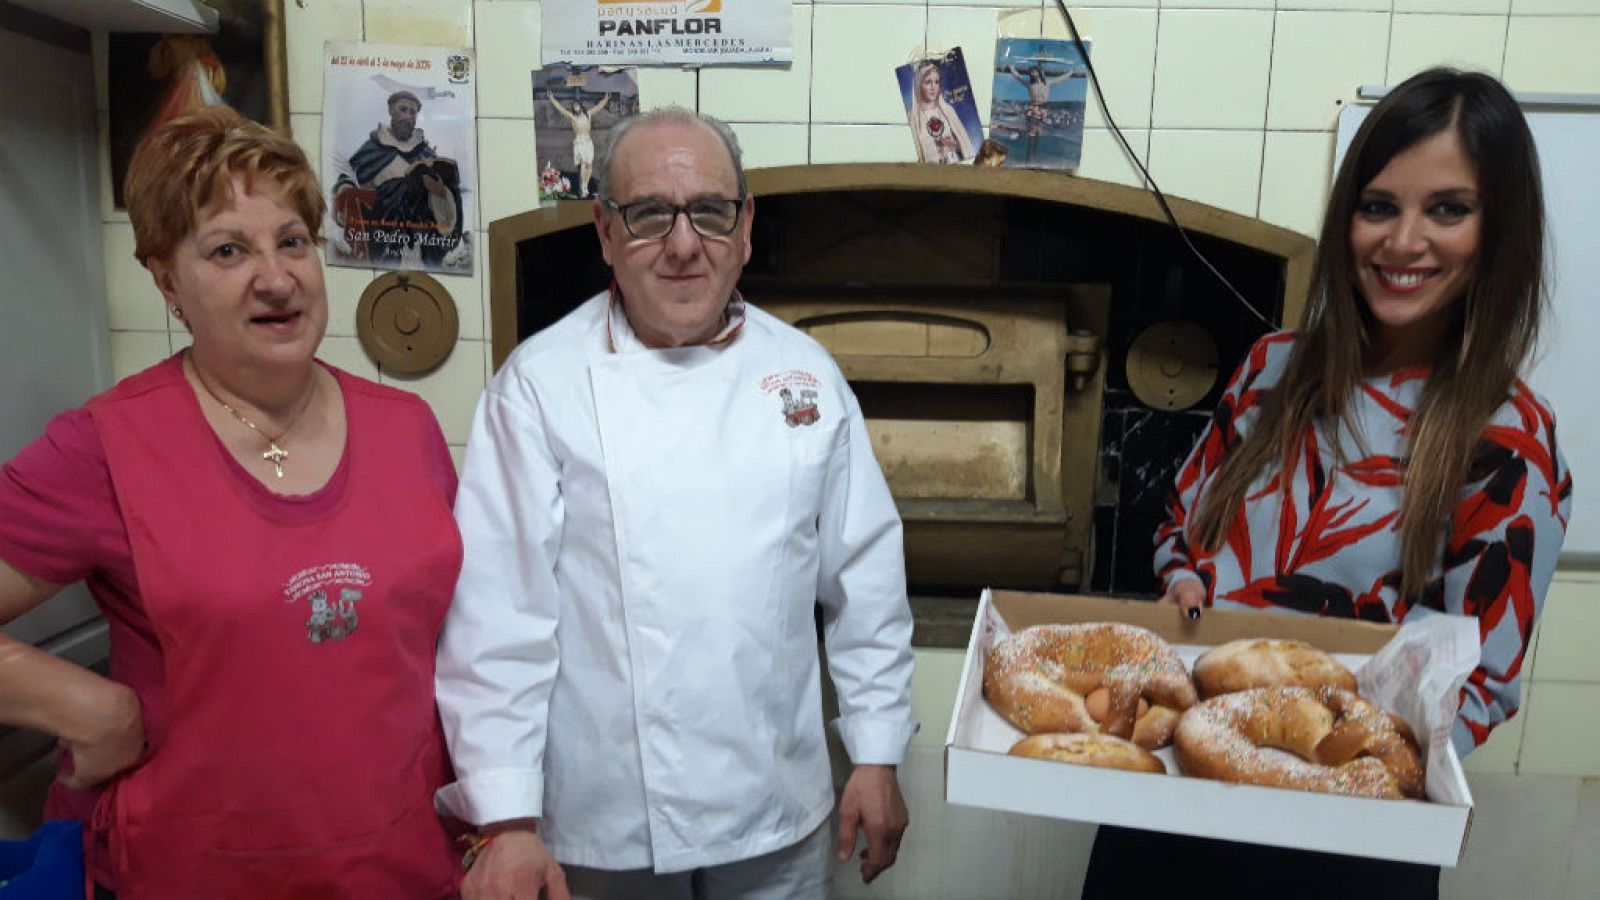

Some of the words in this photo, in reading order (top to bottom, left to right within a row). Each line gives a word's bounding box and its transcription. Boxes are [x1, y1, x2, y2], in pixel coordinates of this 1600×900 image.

[600, 18, 721, 36] PANFLOR
[587, 40, 642, 48] HARINAS
[647, 40, 671, 48] LAS
[675, 38, 745, 47] MERCEDES
[348, 228, 370, 241] San
[373, 229, 410, 244] Pedro
[414, 231, 458, 247] Mártir
